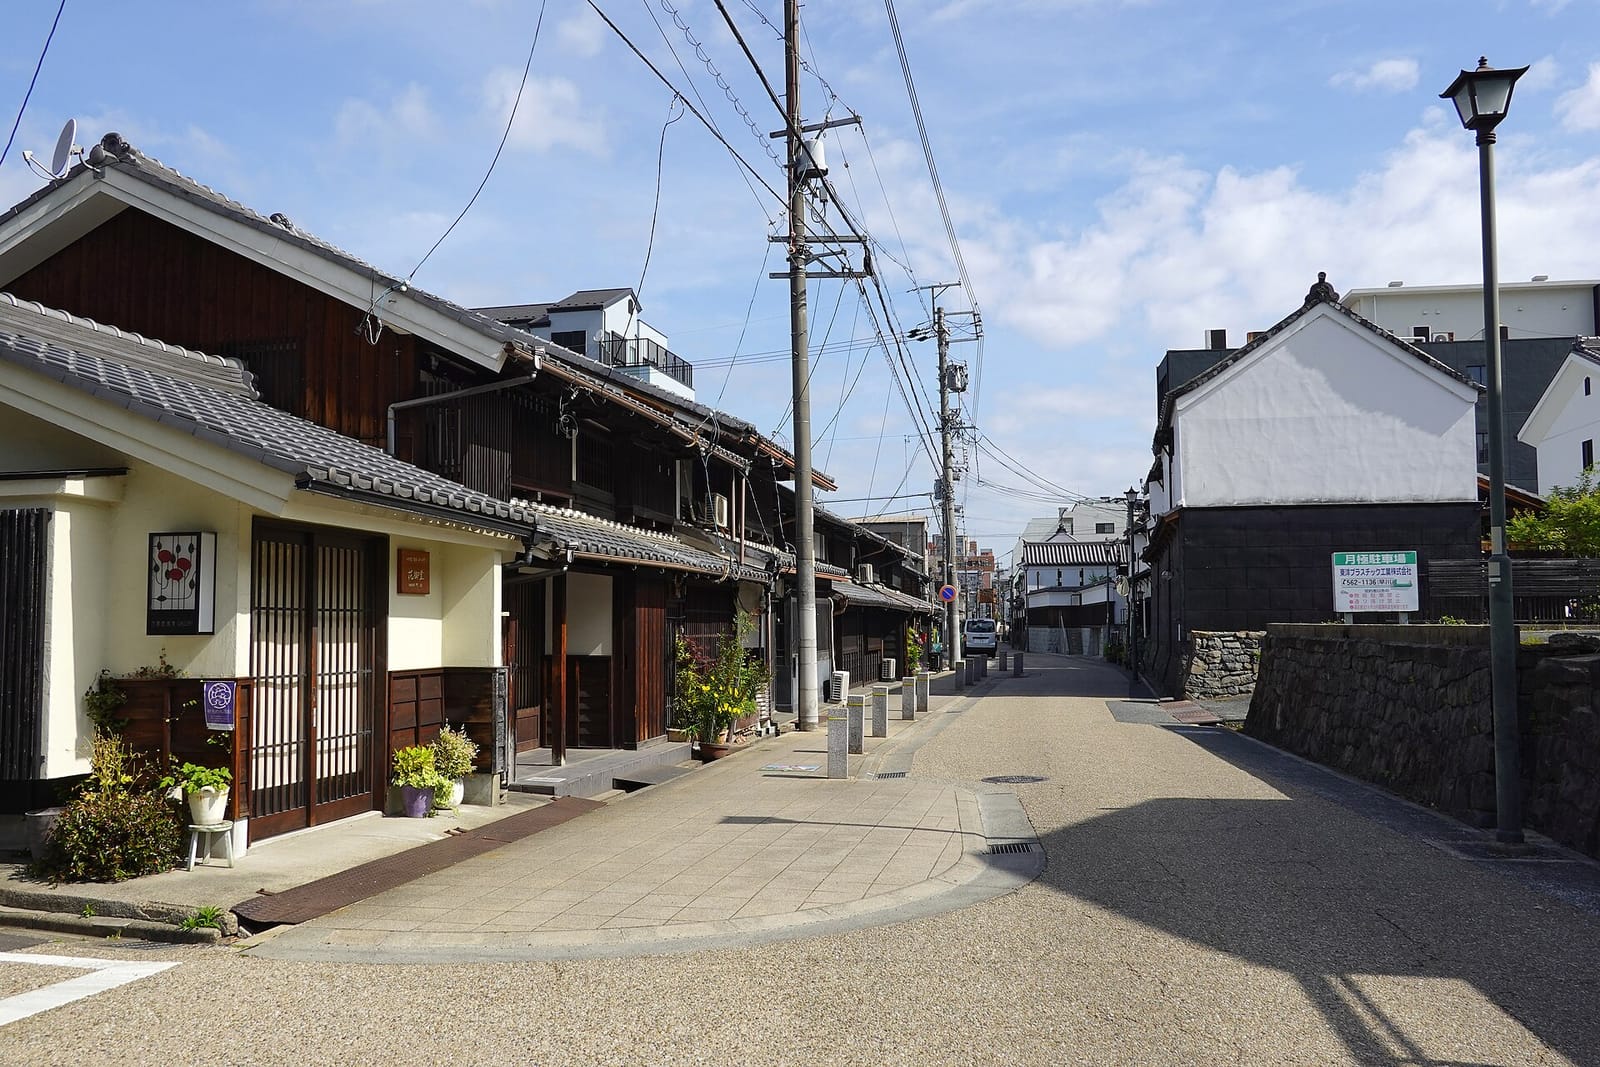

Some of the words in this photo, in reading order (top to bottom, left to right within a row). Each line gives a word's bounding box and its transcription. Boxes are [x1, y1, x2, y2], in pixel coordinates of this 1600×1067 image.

[1345, 553, 1406, 565] 月極駐車場
